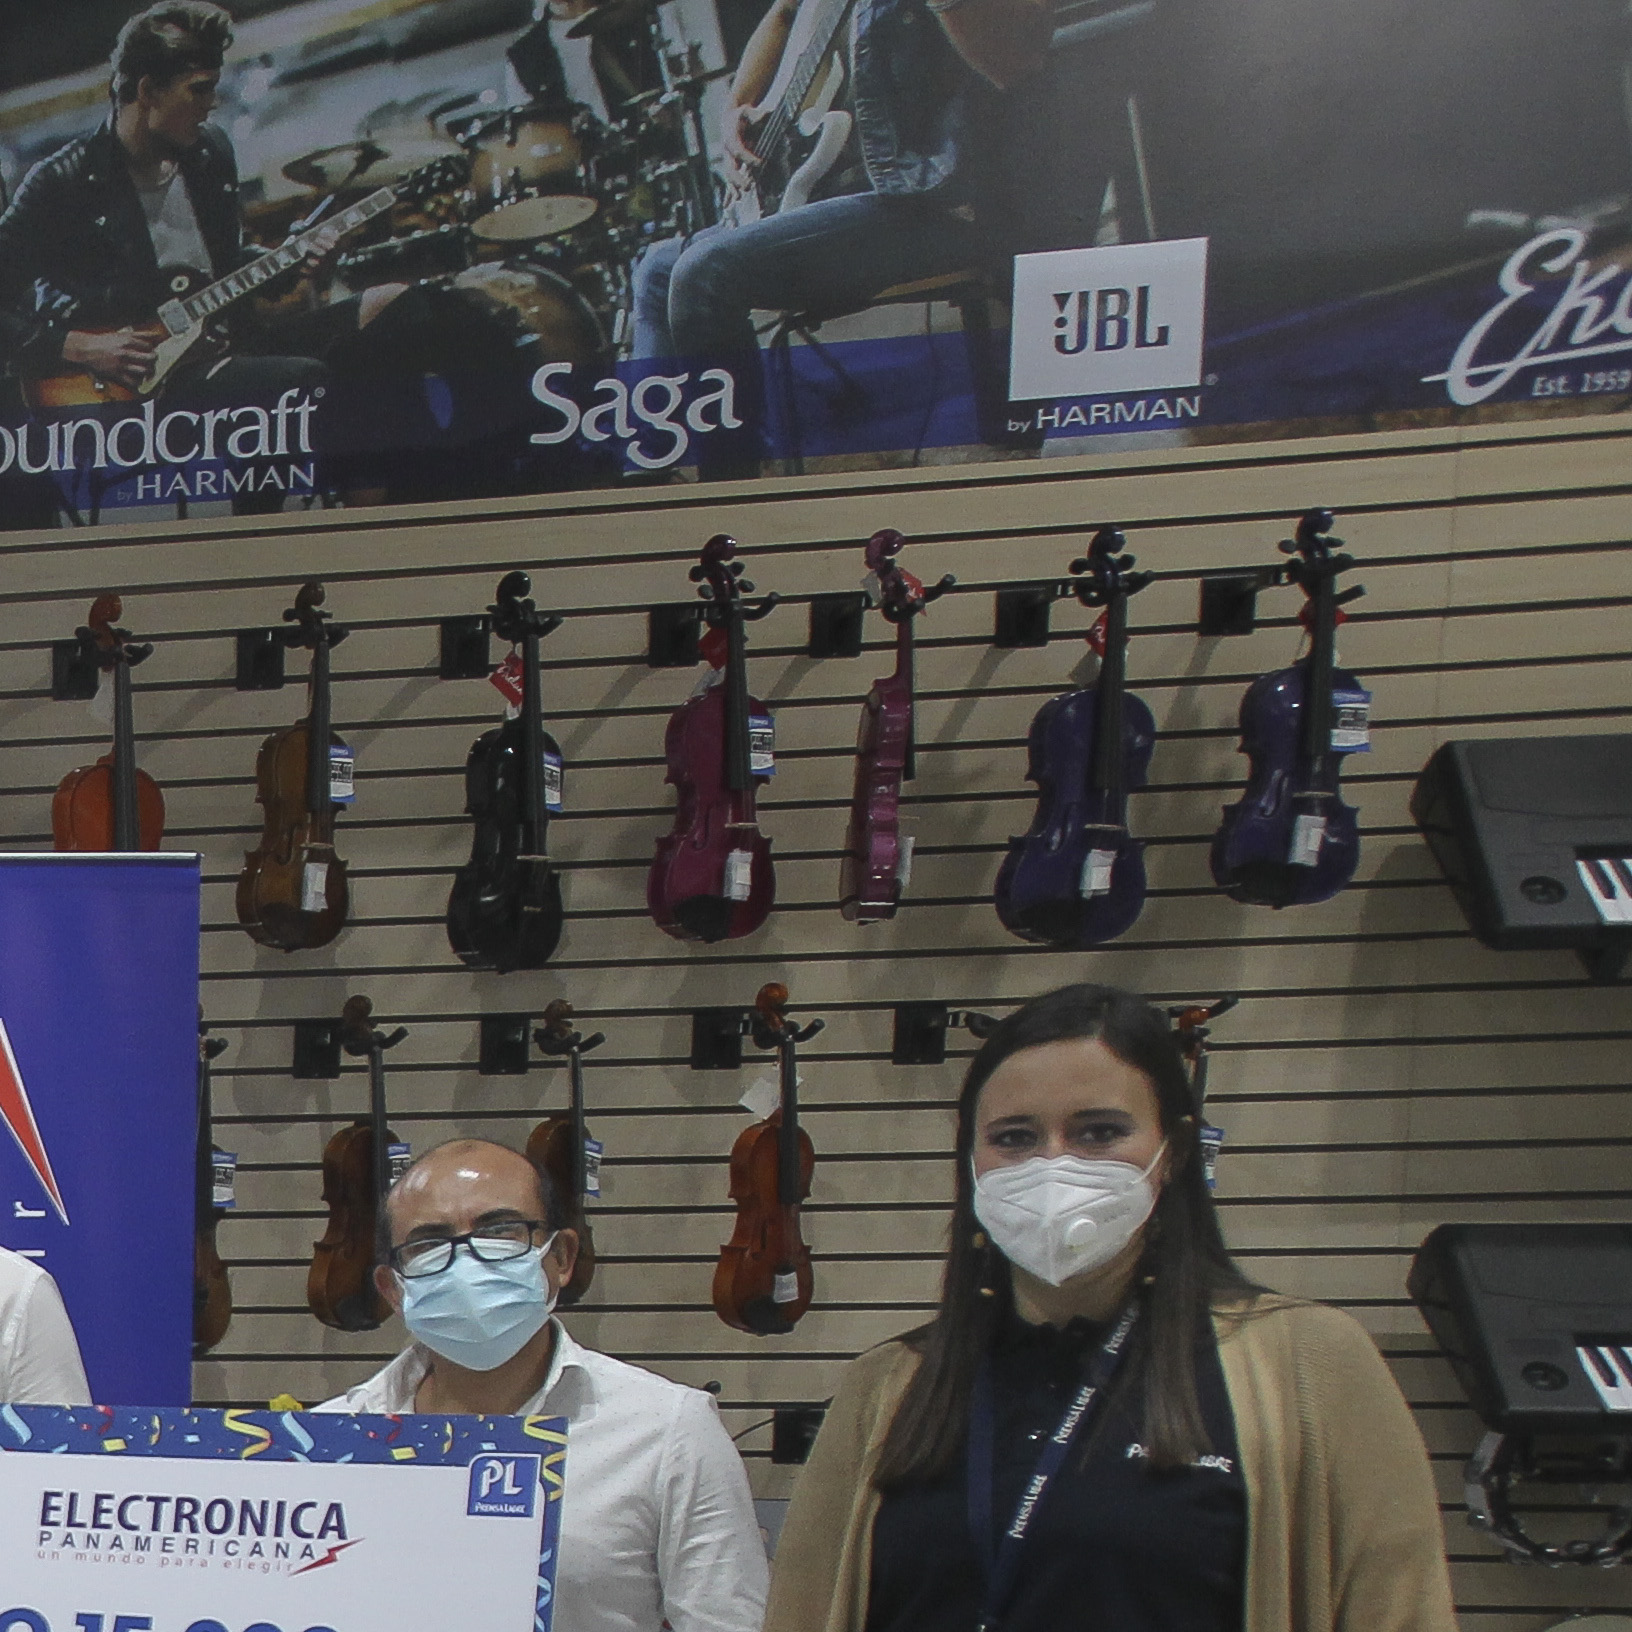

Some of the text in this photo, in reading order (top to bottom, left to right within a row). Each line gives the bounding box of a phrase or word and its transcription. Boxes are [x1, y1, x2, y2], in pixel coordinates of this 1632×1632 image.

[1053, 285, 1169, 355] JBL
[1532, 375, 1573, 396] Est.
[530, 361, 744, 469] Saga
[1008, 395, 1201, 433] by HARMAN
[137, 463, 314, 499] HARMAN
[480, 1459, 523, 1498] PL
[40, 1490, 348, 1540] ELECTRONICA
[37, 1549, 293, 1574] un mundo para elegir
[39, 1531, 315, 1560] PANAMERICANA
